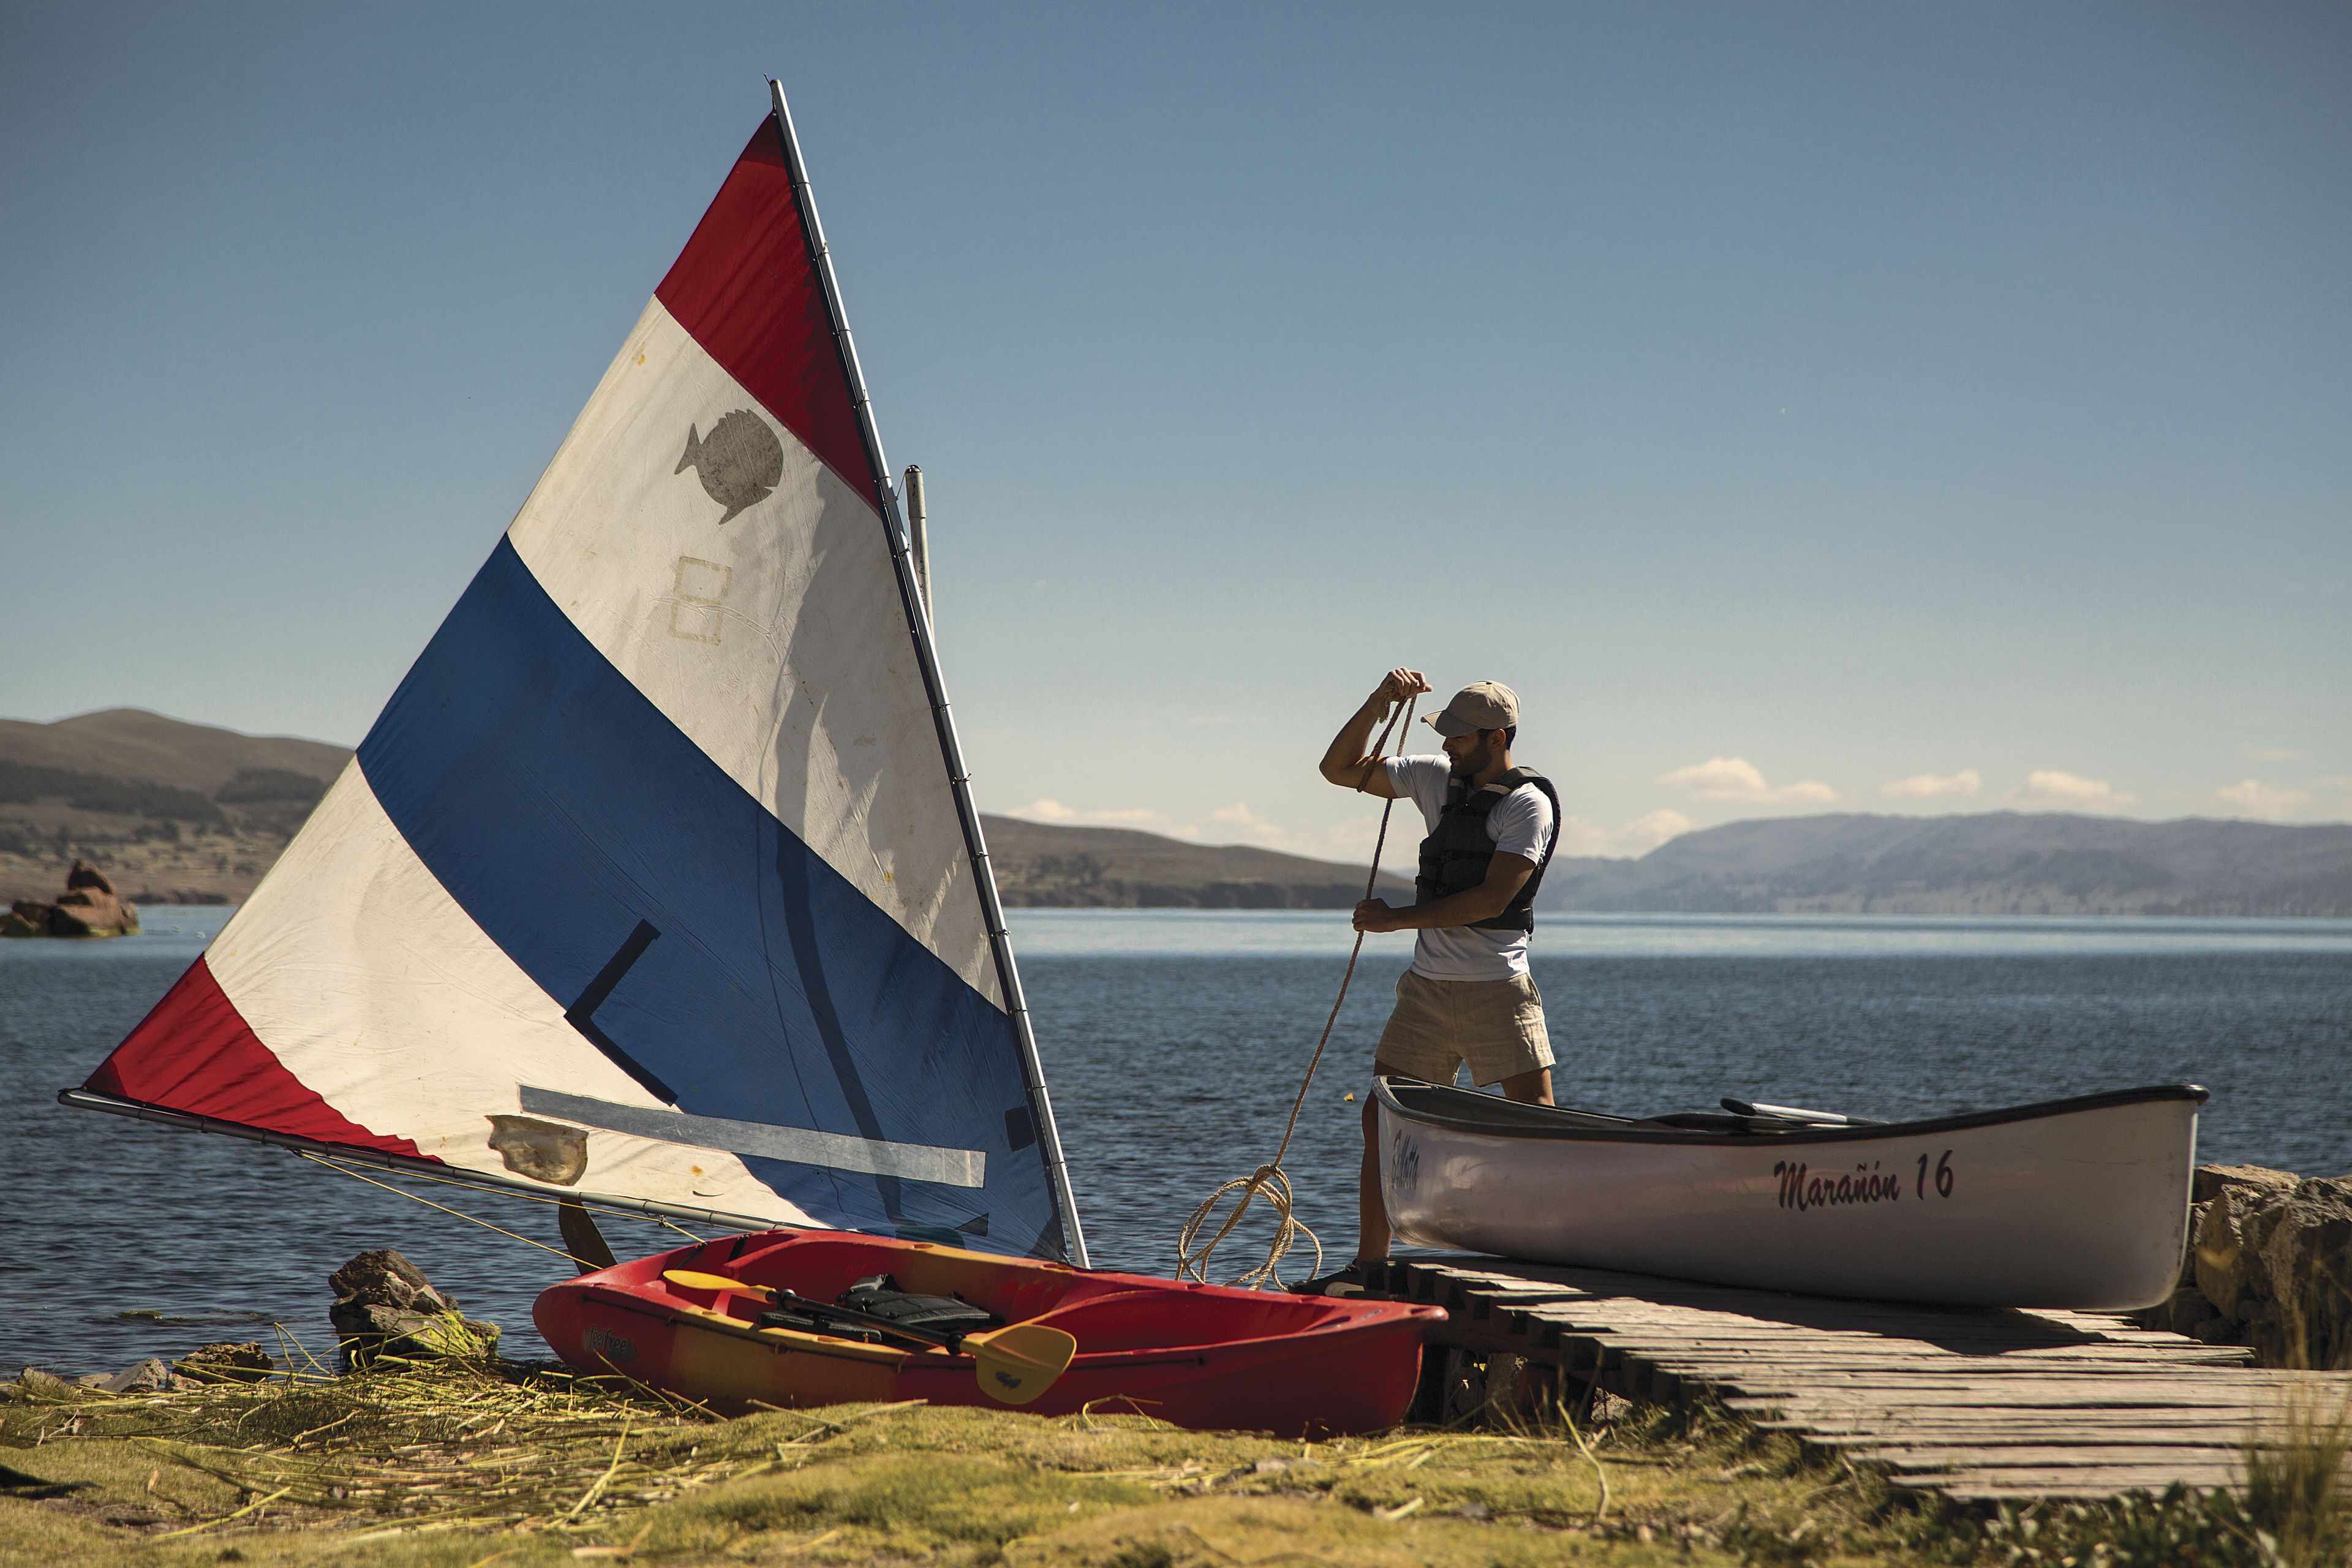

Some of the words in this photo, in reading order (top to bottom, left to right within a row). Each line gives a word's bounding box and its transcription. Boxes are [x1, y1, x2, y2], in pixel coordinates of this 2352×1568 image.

[1774, 1160, 1899, 1211] Marañón
[1917, 1150, 1953, 1200] 16
[589, 1323, 628, 1352] feelfree
